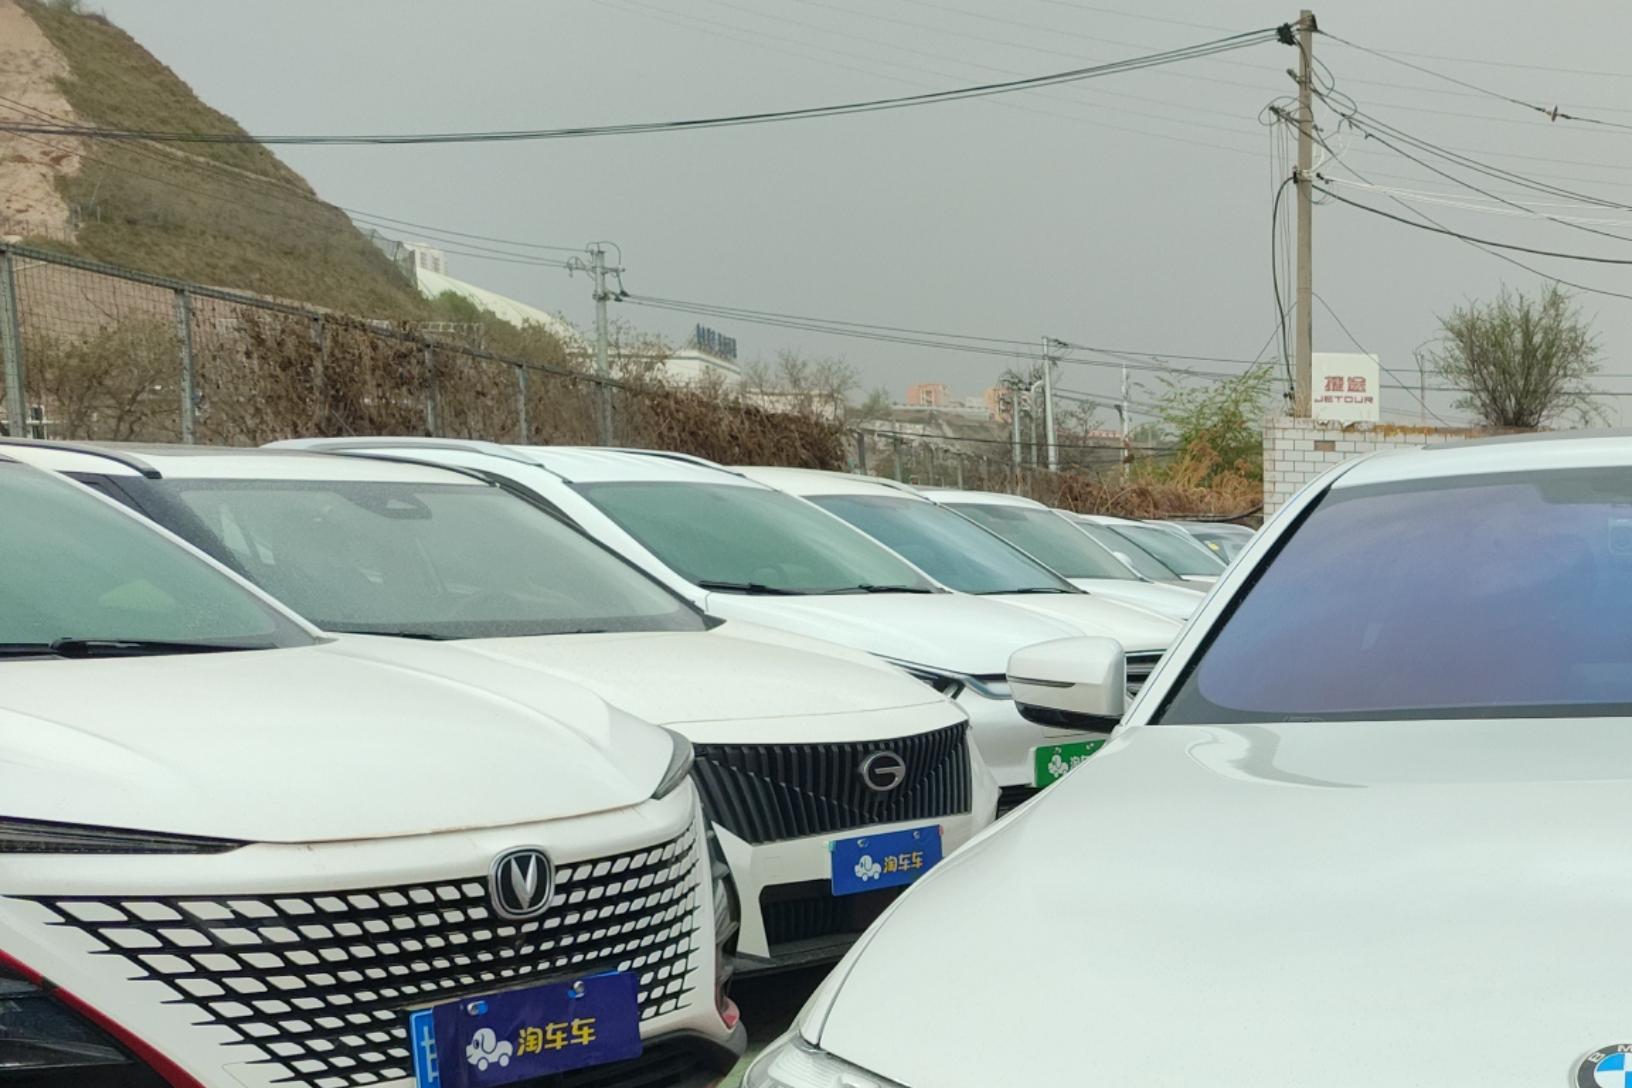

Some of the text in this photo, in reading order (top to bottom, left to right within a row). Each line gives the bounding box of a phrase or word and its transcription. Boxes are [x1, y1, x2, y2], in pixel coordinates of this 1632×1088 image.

[1314, 395, 1374, 404] JETOUR
[883, 851, 924, 873] 淘车车
[517, 1017, 596, 1056] 淘车车
